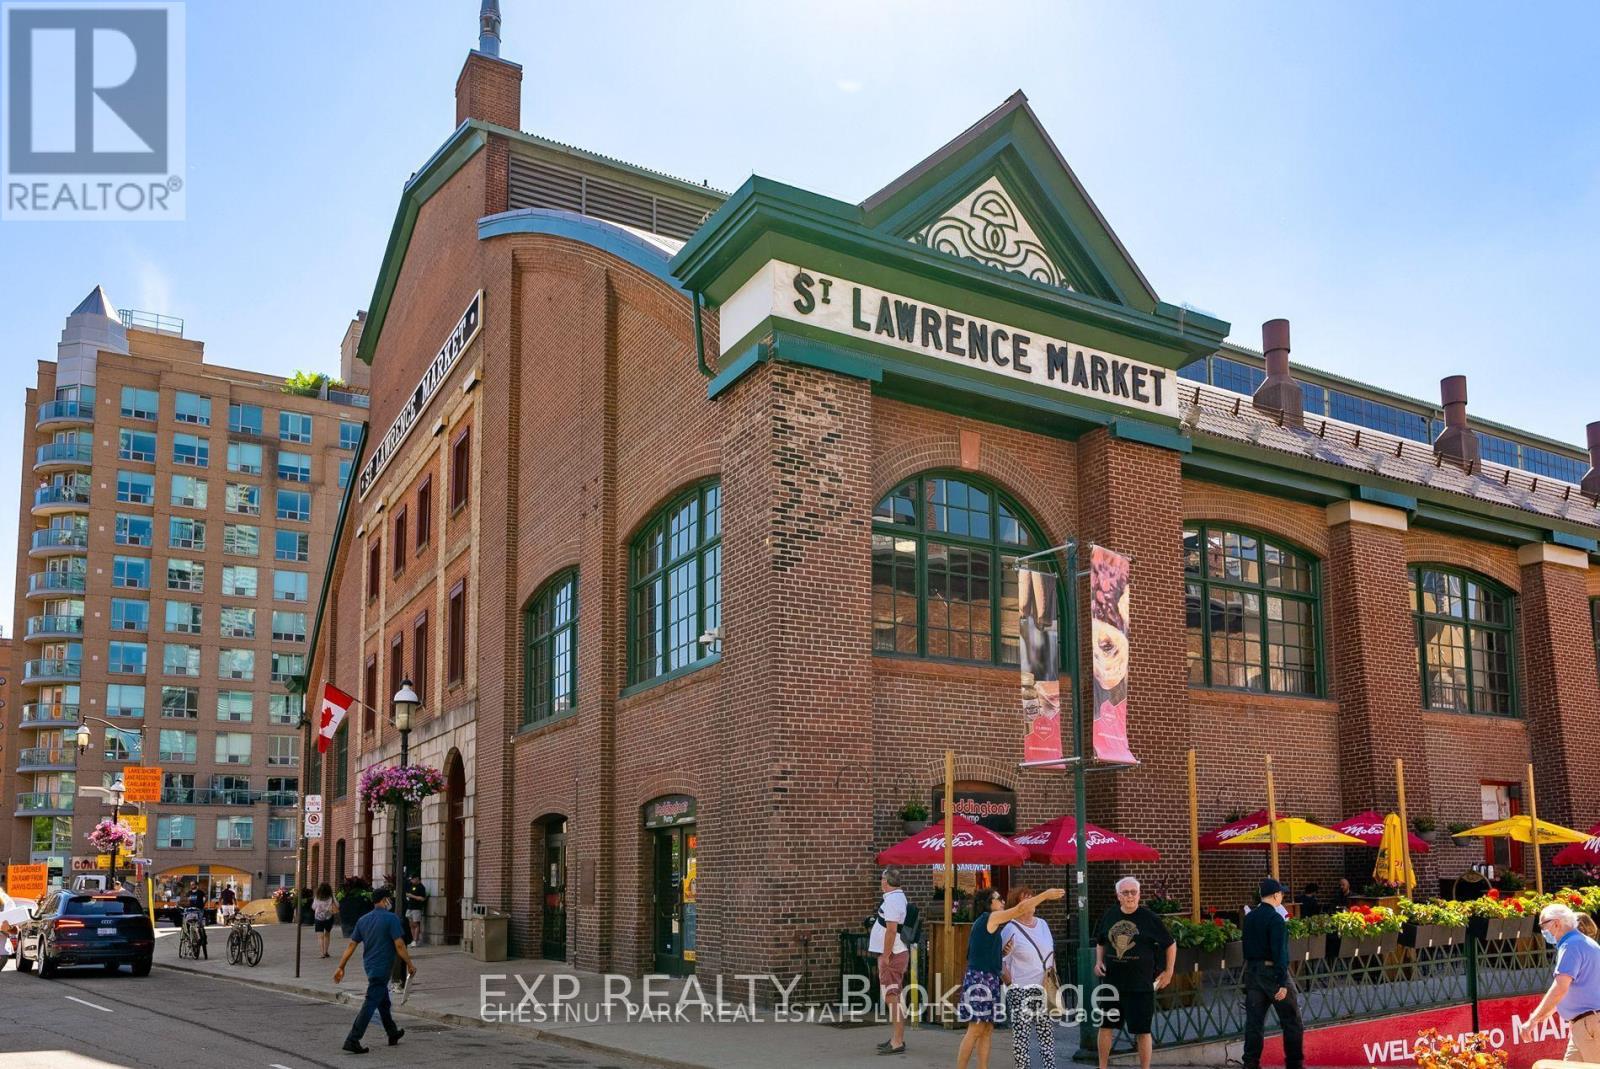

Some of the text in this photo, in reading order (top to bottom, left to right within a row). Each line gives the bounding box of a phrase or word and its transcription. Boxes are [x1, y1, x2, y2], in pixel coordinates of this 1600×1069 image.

[852, 287, 1032, 374] LAWRENCE
[1046, 343, 1166, 406] MARKET
[375, 394, 417, 473] LAWRENCE
[421, 317, 466, 405] MARKET
[941, 799, 1011, 817] addington's
[918, 836, 984, 851] Mlson
